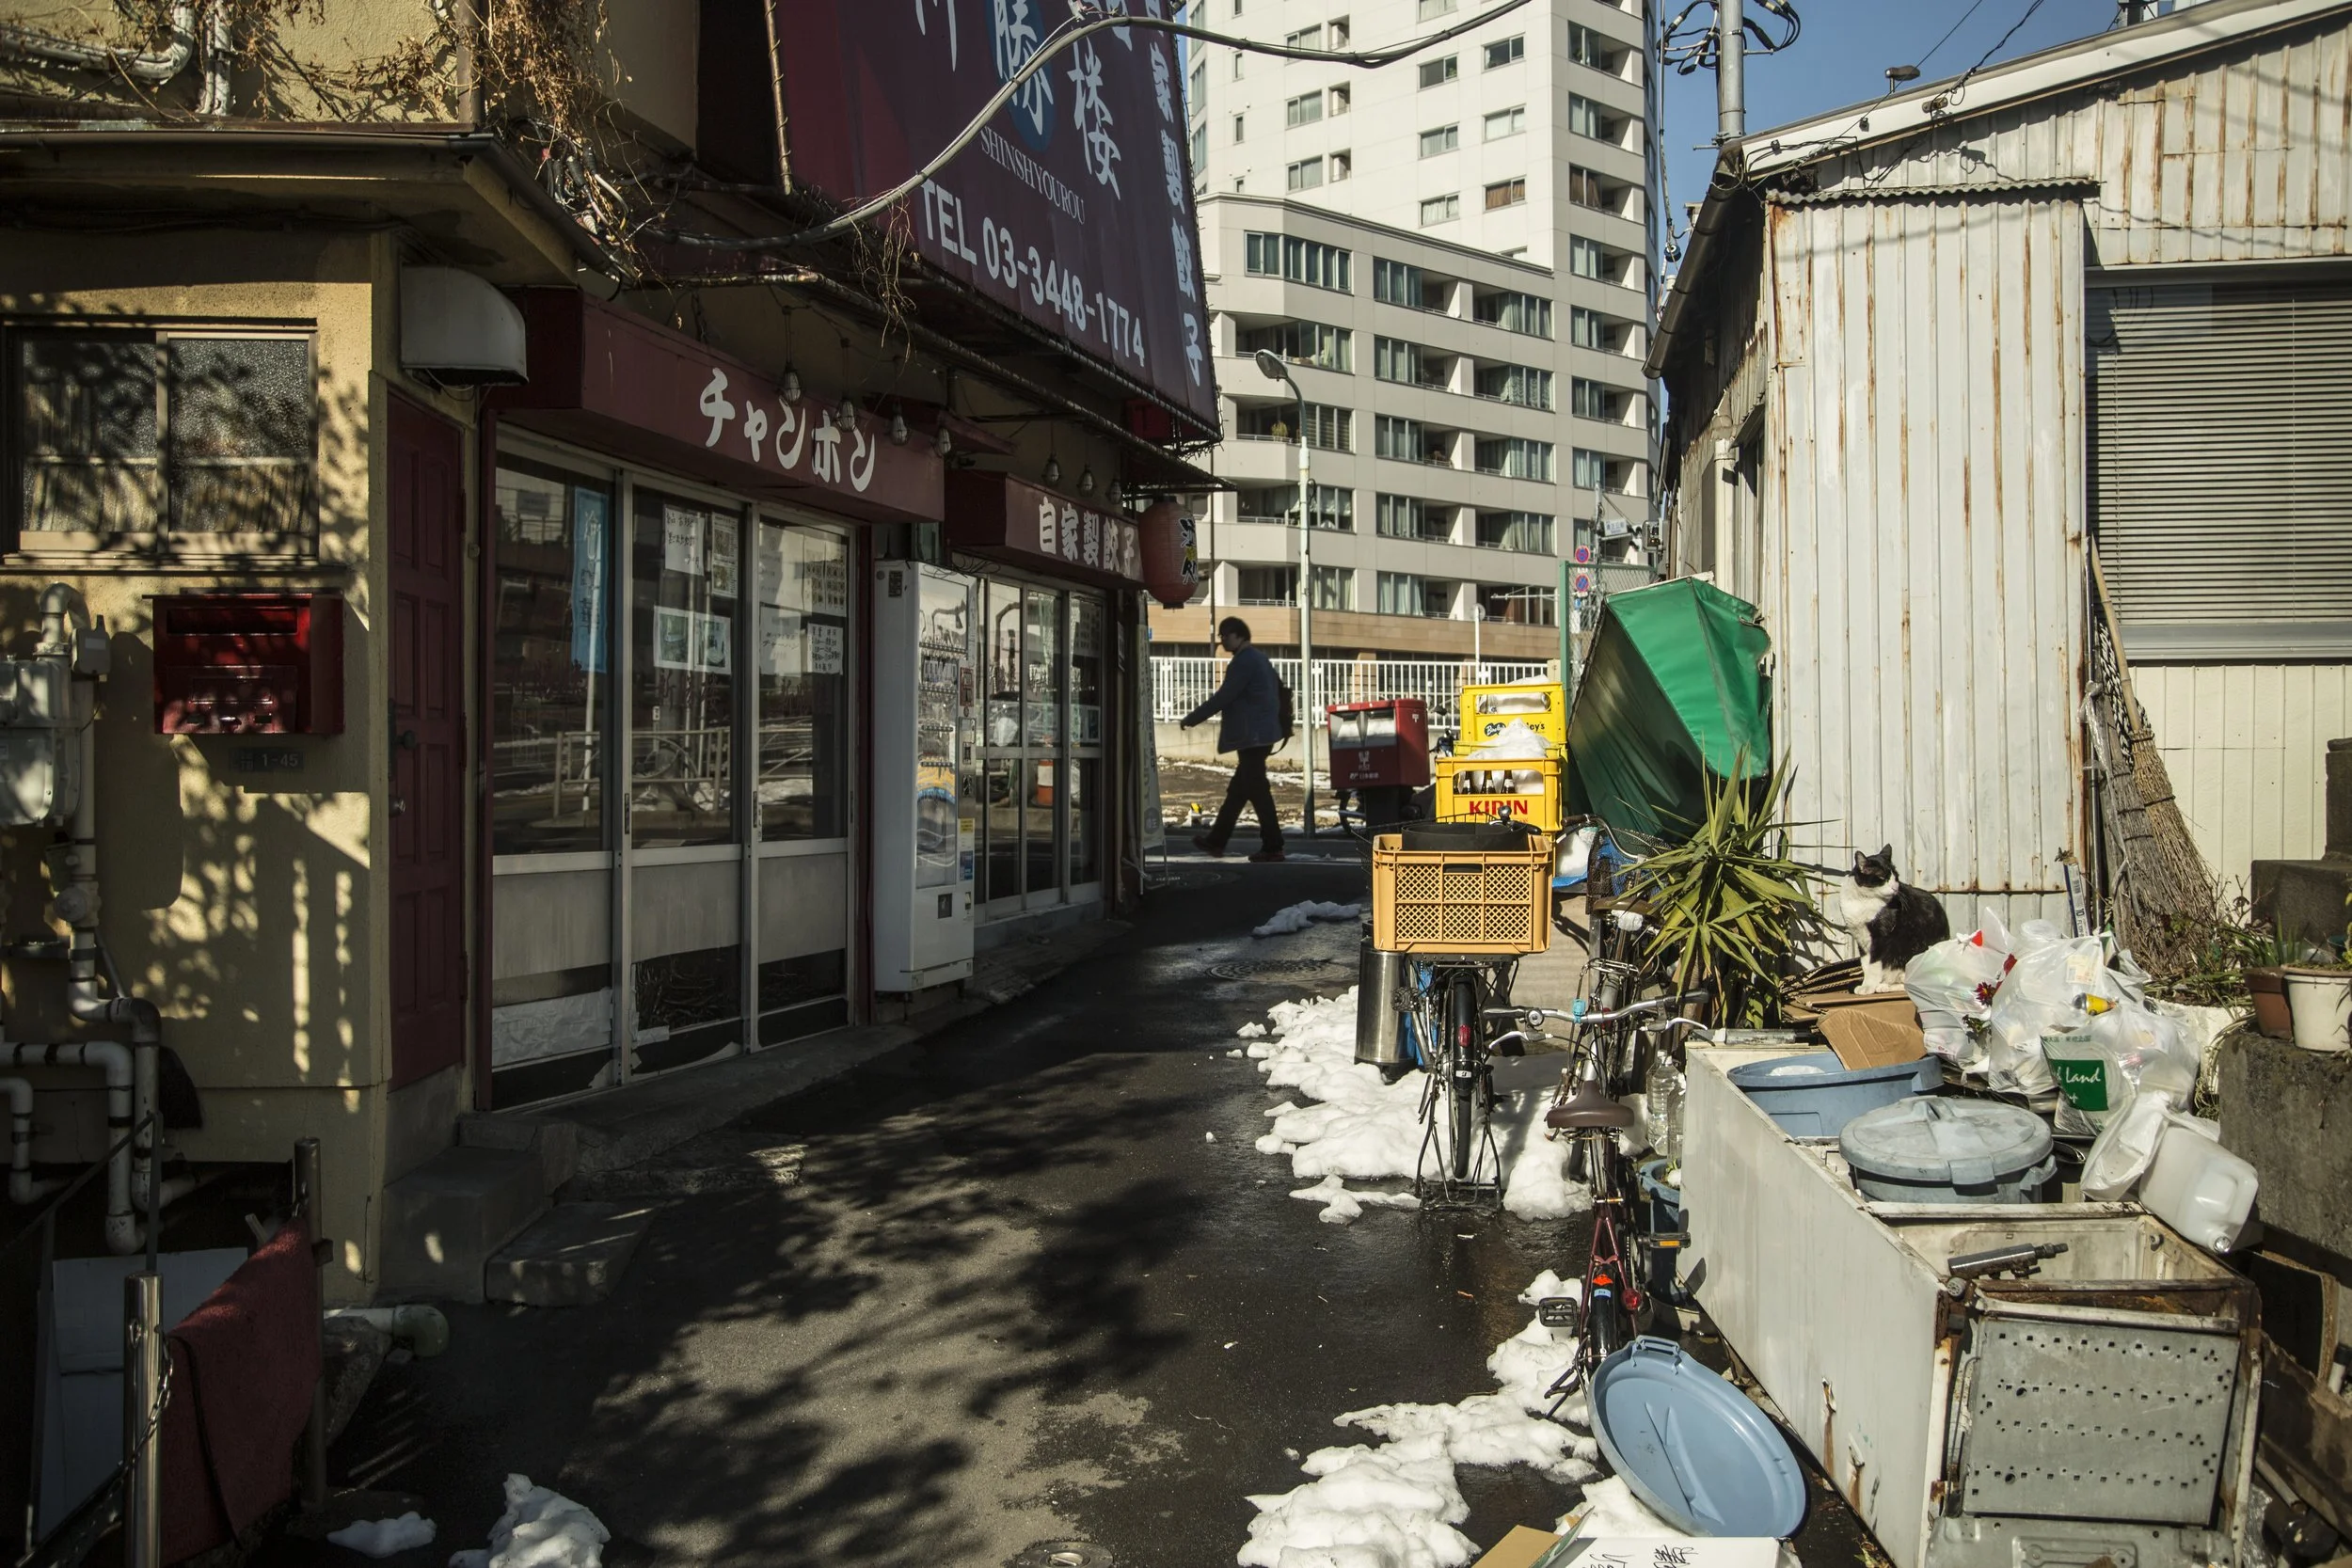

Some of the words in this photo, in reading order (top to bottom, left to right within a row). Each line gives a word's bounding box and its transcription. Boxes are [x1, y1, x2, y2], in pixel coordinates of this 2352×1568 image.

[979, 124, 1086, 226] SHINSHYOUROU
[920, 178, 977, 266] TEL
[982, 216, 1145, 368] 03-3448-1774
[1039, 496, 1136, 581] 自家製餃子
[262, 752, 299, 768] 1-45
[2065, 1067, 2102, 1084] Land
